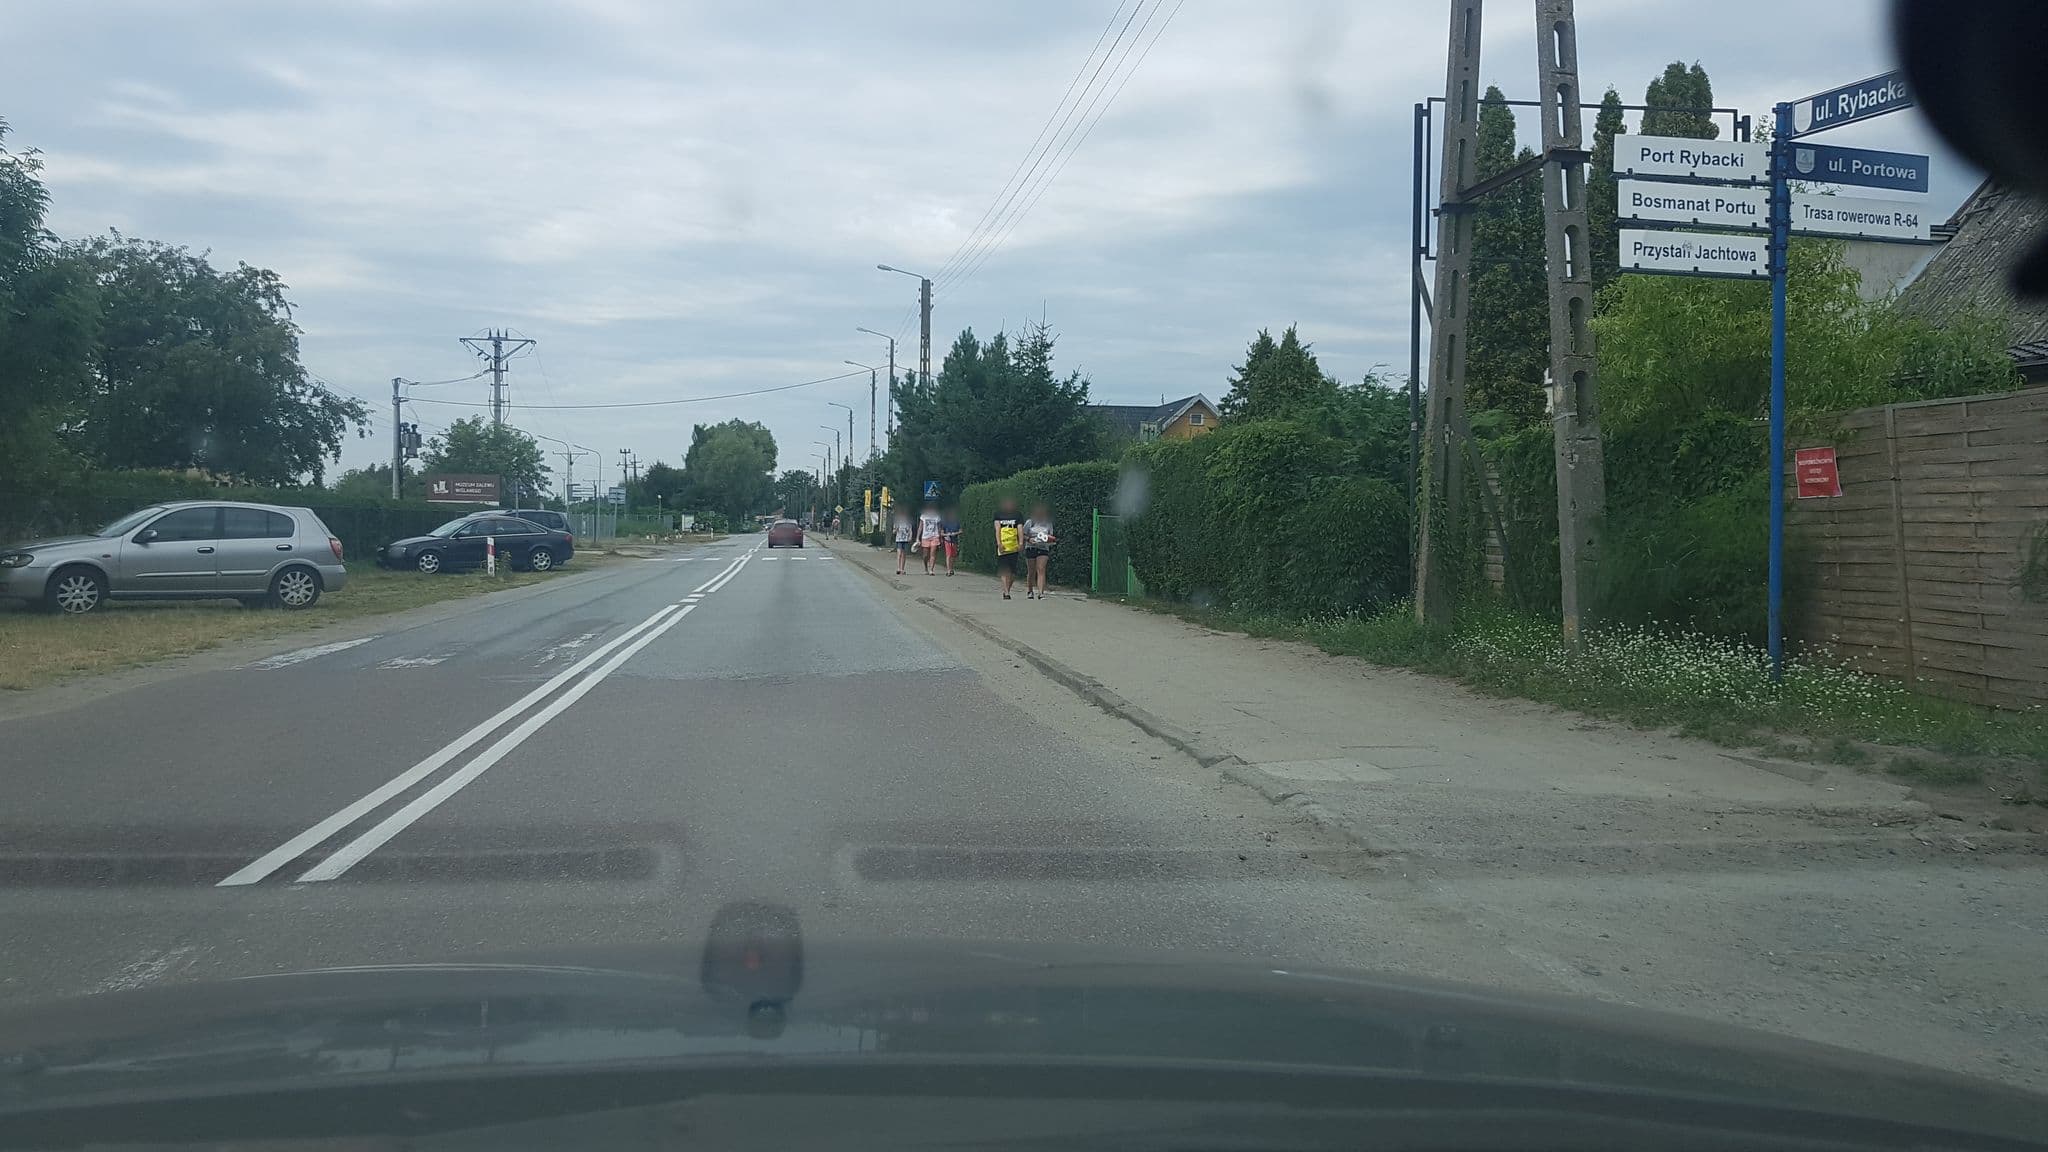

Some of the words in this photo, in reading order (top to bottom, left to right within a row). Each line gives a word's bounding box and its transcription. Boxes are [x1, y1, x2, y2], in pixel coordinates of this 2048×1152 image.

[1816, 99, 1833, 121] ul.
[1838, 80, 1906, 117] Rybacka
[1640, 147, 1674, 163] Port
[1680, 150, 1744, 168] Rybacki
[1828, 158, 1847, 172] ul.
[1852, 159, 1917, 179] Portowa
[1632, 192, 1710, 212] Bosmanat
[1715, 198, 1756, 215] Portu
[1803, 204, 1834, 221] Trasa
[1837, 210, 1891, 225] rowerowa
[1894, 212, 1919, 228] R-64
[1695, 244, 1757, 262] Jachtowa
